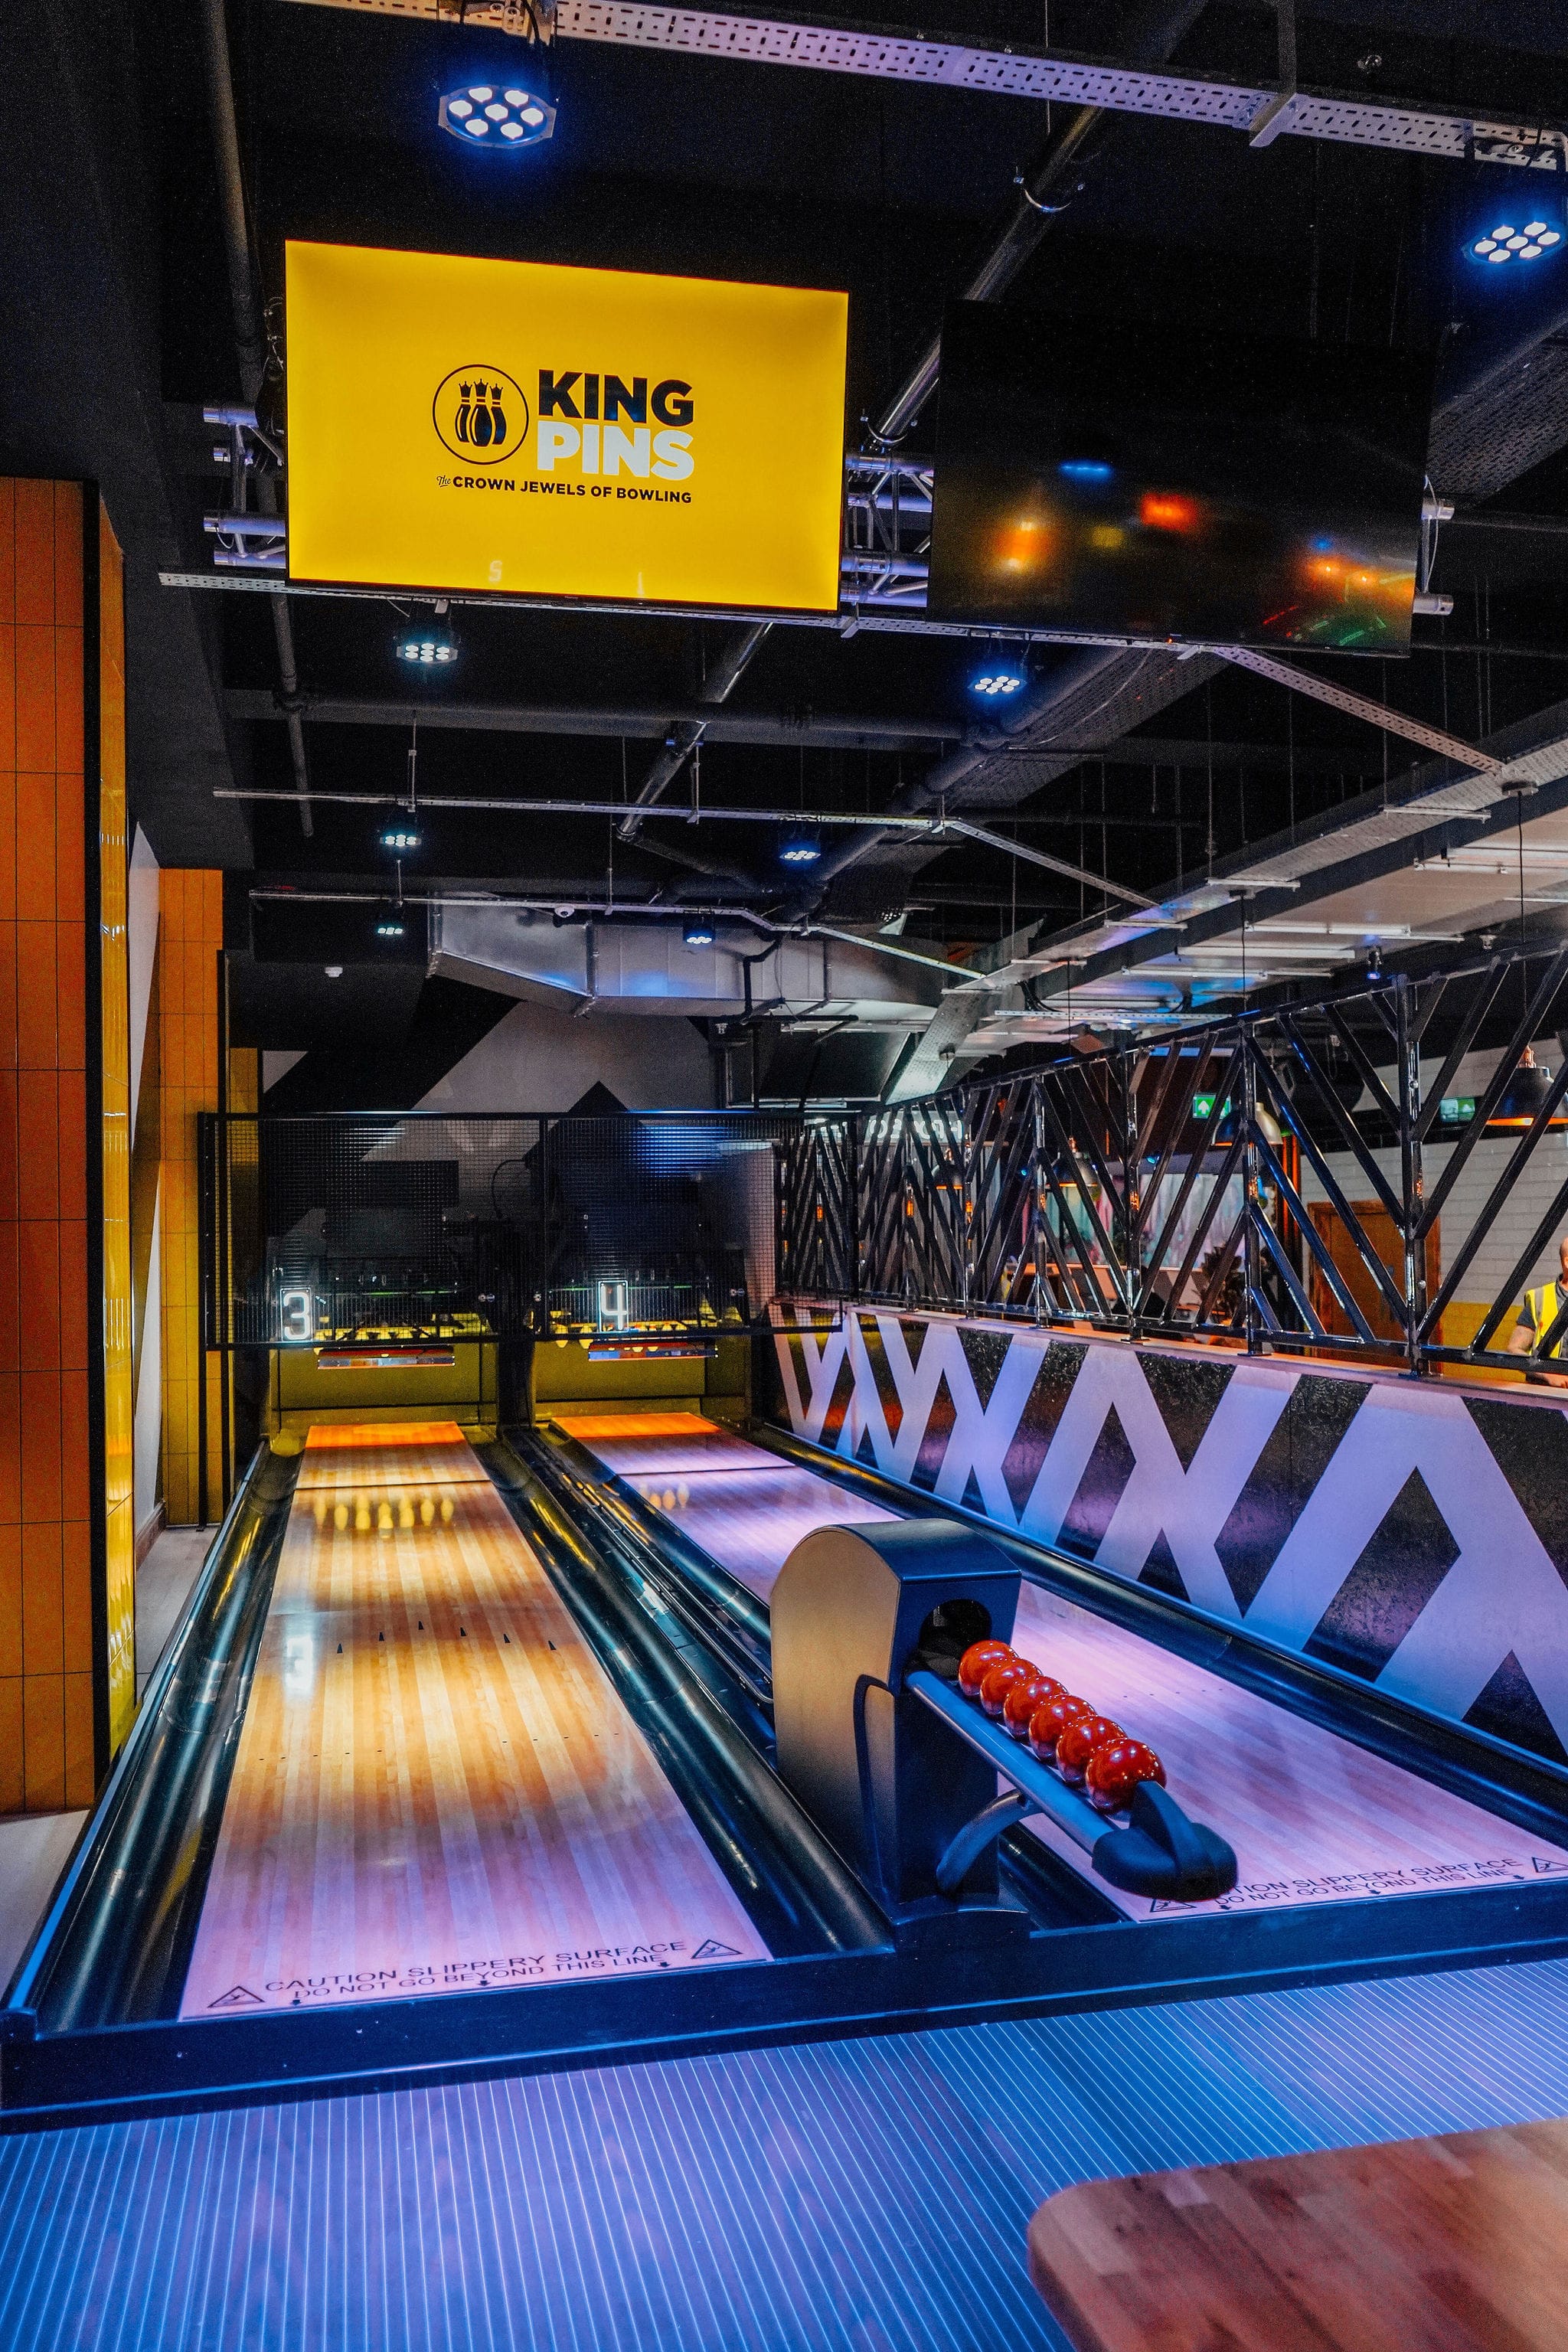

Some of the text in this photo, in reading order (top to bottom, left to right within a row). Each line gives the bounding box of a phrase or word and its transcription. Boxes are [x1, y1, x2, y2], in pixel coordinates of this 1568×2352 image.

[538, 368, 694, 427] KING
[537, 420, 695, 481] PINS
[436, 475, 692, 503] The CROWN JEWELS OF BOWLING
[283, 1292, 310, 1341] 3
[601, 1285, 628, 1331] 4
[1214, 1869, 1514, 1905] DO NOT GO BEYOND THIS LINE
[1224, 1858, 1524, 1896] TION SLIPPERY SURFACE
[266, 1941, 688, 1991] CAUTION SLIPPERY SURFACE
[294, 1955, 666, 1998] DO NOT GO BEYOND THIS LINE
